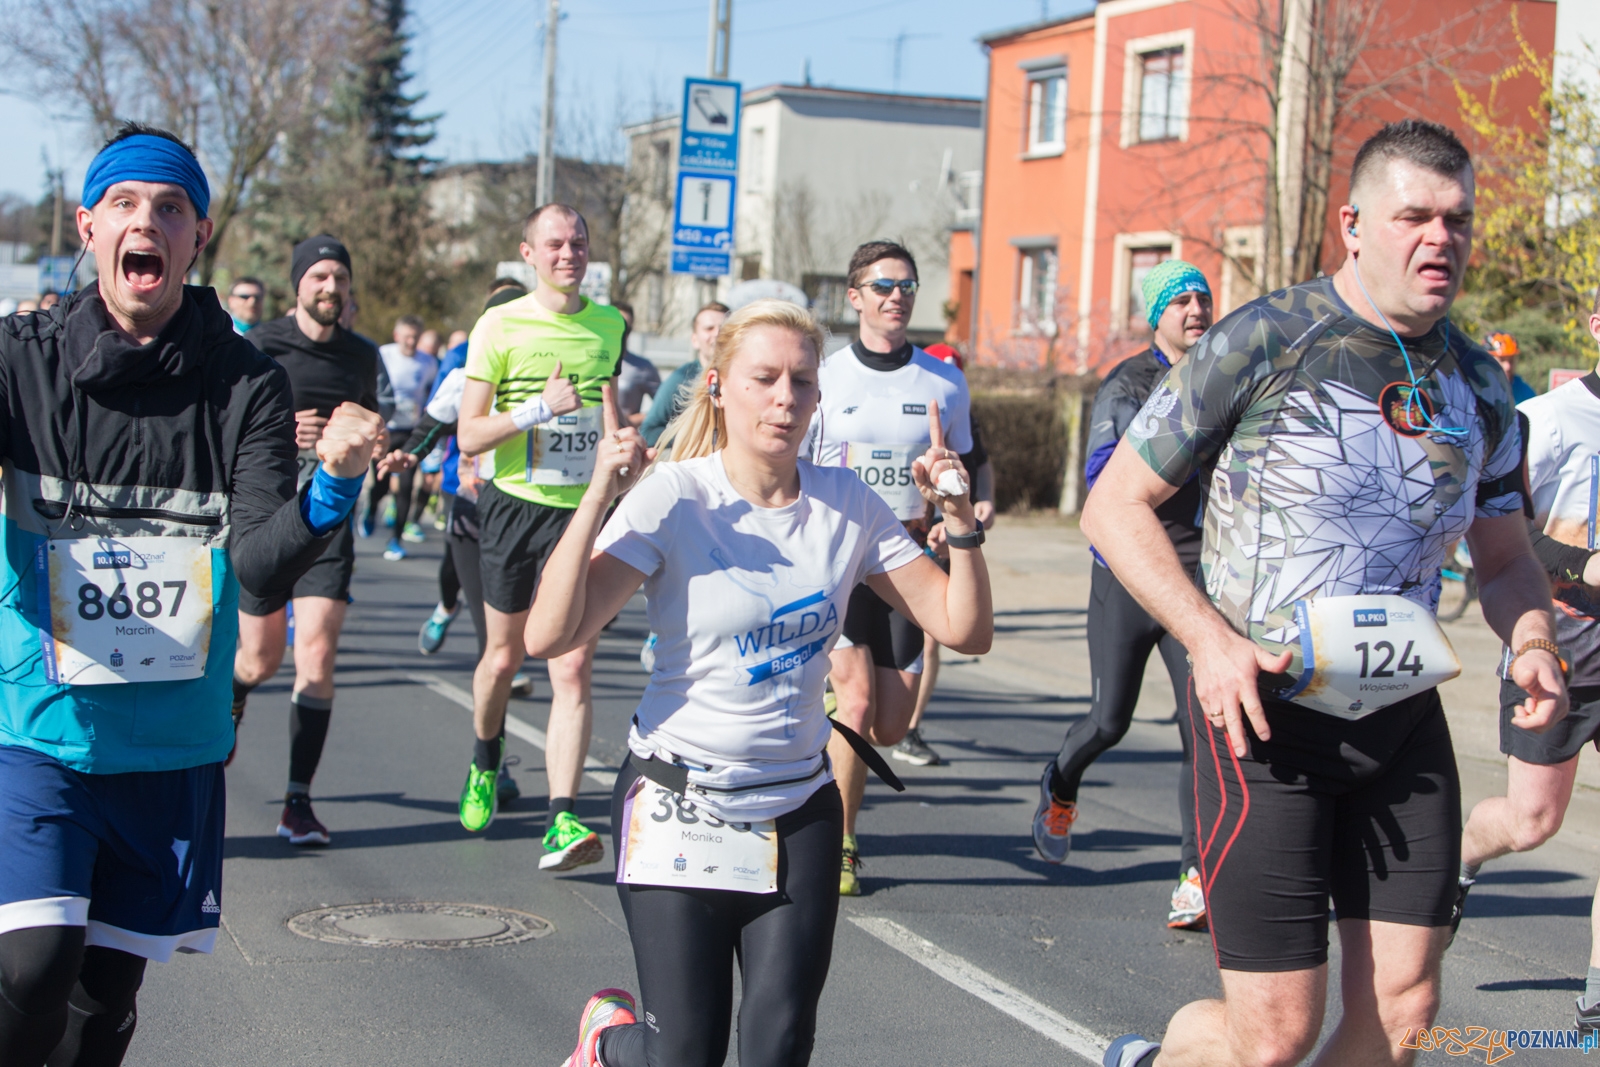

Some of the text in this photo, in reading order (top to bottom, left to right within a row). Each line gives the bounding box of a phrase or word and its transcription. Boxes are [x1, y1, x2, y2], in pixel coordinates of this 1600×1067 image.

[549, 431, 598, 452] 2139
[854, 466, 916, 486] 1085
[96, 556, 108, 565] 10.
[108, 555, 128, 564] PKO
[77, 580, 187, 620] 8687
[1356, 614, 1368, 623] 10.
[1368, 613, 1386, 622] PKO
[115, 625, 155, 636] Marcin
[733, 602, 838, 658] WILDA
[140, 657, 156, 666] 4F
[771, 643, 812, 674] Biega!
[1354, 640, 1424, 678] 124
[1359, 683, 1409, 693] Wojciech
[681, 830, 723, 843] Monika
[703, 865, 719, 874] 4F
